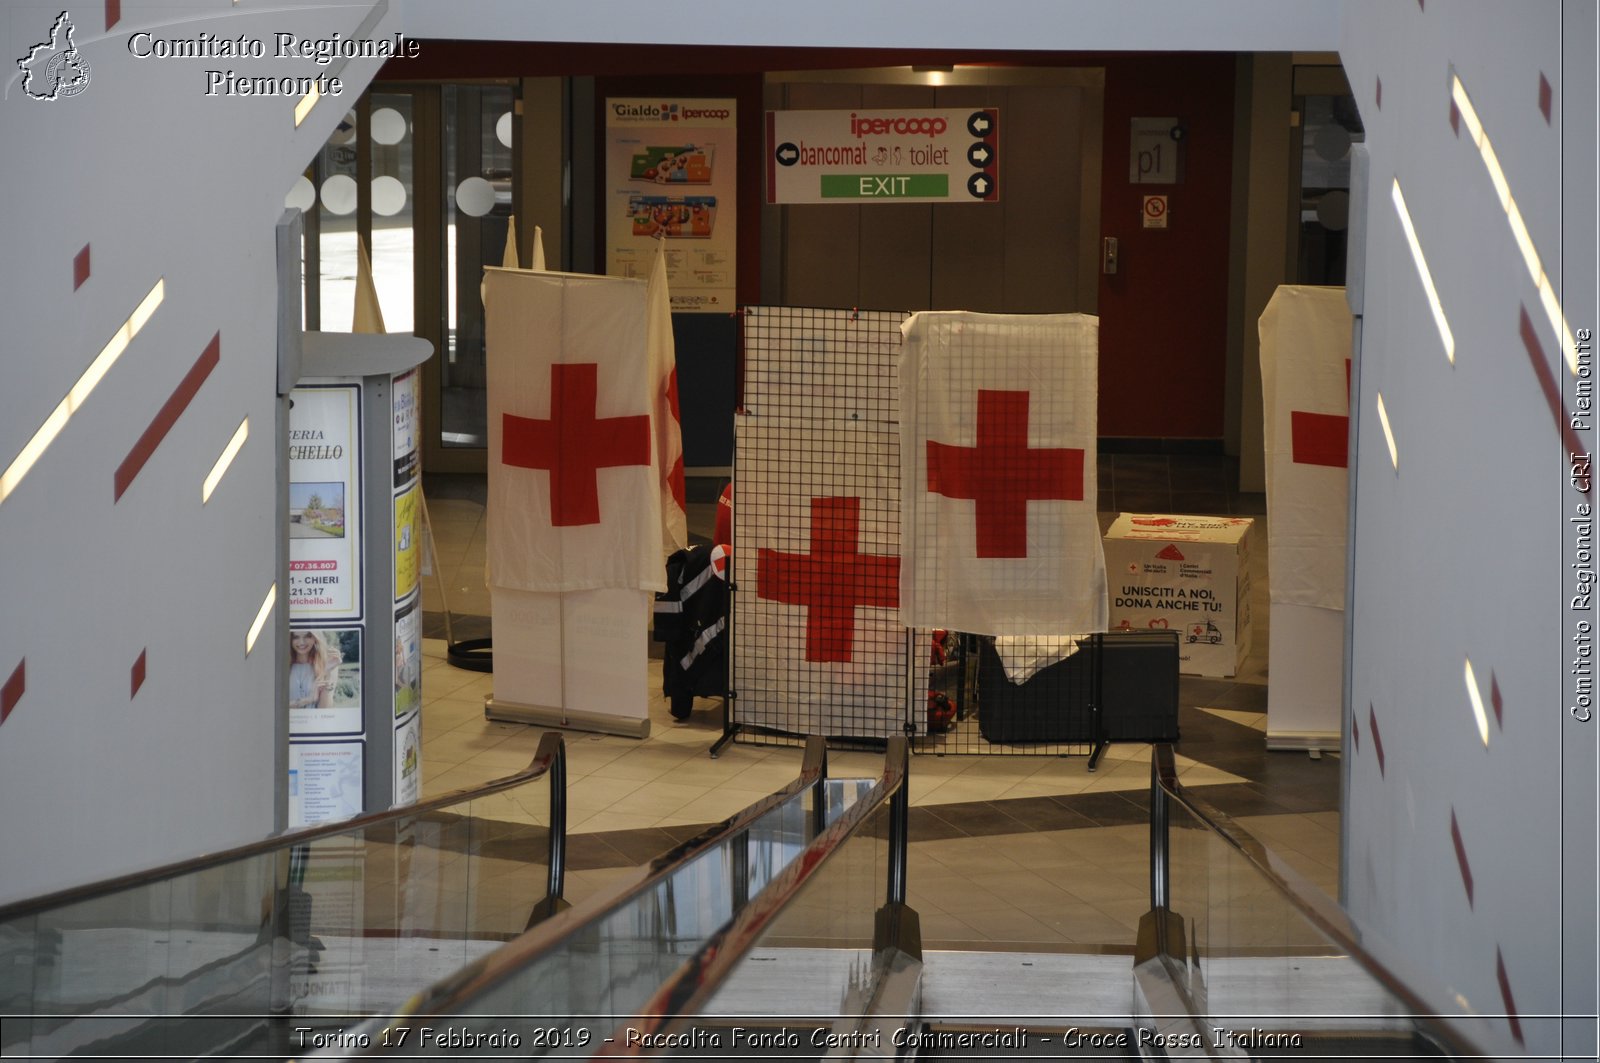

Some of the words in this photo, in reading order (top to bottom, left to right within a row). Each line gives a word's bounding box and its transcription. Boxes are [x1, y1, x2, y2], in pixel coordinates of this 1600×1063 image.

[615, 104, 660, 116] Gialdo
[850, 113, 948, 138] ipercoop
[800, 141, 867, 166] bancomat
[910, 144, 949, 166] toilet
[1138, 144, 1161, 182] p1
[859, 177, 911, 195] EXIT
[304, 576, 339, 584] CHIERI
[1122, 586, 1174, 597] UNISCITI
[1177, 588, 1186, 598] A
[1190, 589, 1216, 601] NOI,
[1115, 598, 1152, 608] DONA
[1155, 600, 1199, 611] ANCHE
[1202, 602, 1222, 612] TU!
